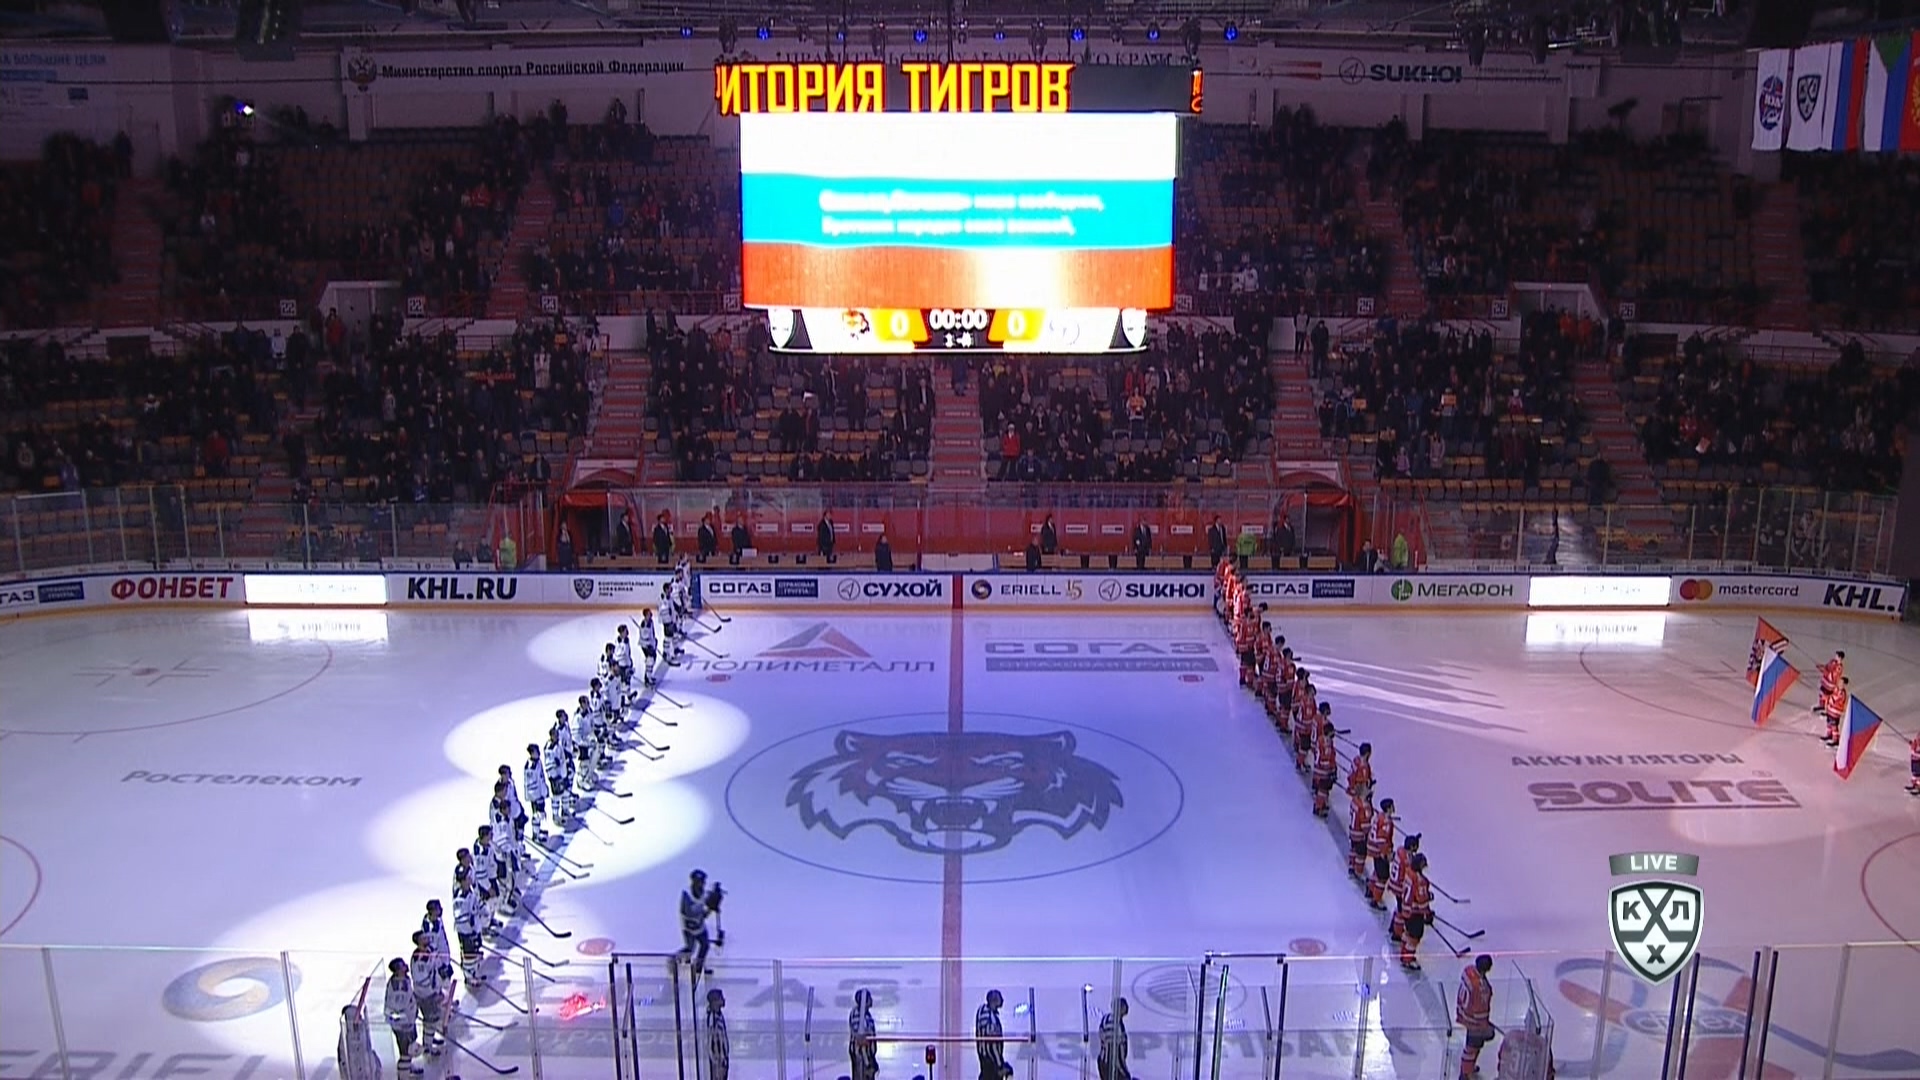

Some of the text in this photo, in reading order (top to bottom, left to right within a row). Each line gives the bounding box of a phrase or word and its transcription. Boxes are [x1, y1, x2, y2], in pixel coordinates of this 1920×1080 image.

[382, 60, 685, 79] Министерство спорта Российской Федерации
[1370, 64, 1463, 83] SUKHOI
[715, 61, 1075, 115] ИТОРИЯ ТИГРОВ
[890, 313, 910, 338] 0
[929, 308, 988, 331] 00:00
[1007, 313, 1026, 338] 0
[111, 577, 234, 599] ФОНБЕТ
[407, 577, 518, 600] KHL.RU
[709, 582, 772, 594] СОГАЗ
[863, 579, 943, 598] СУХОЙ
[1000, 583, 1062, 596] ERIELL
[1125, 582, 1205, 598] SUKHOI
[1249, 583, 1309, 595] СОГАЗ
[1718, 584, 1799, 598] mastercard
[1823, 583, 1902, 612] KHL.
[985, 642, 1211, 654] СОГАЗ
[684, 660, 935, 673] ПОЛИМЕТАЛЛ
[1511, 753, 1745, 767] АККУМУЛЯТОРЫ
[121, 770, 363, 787] Ростелеком
[1527, 779, 1796, 805] SOLITE
